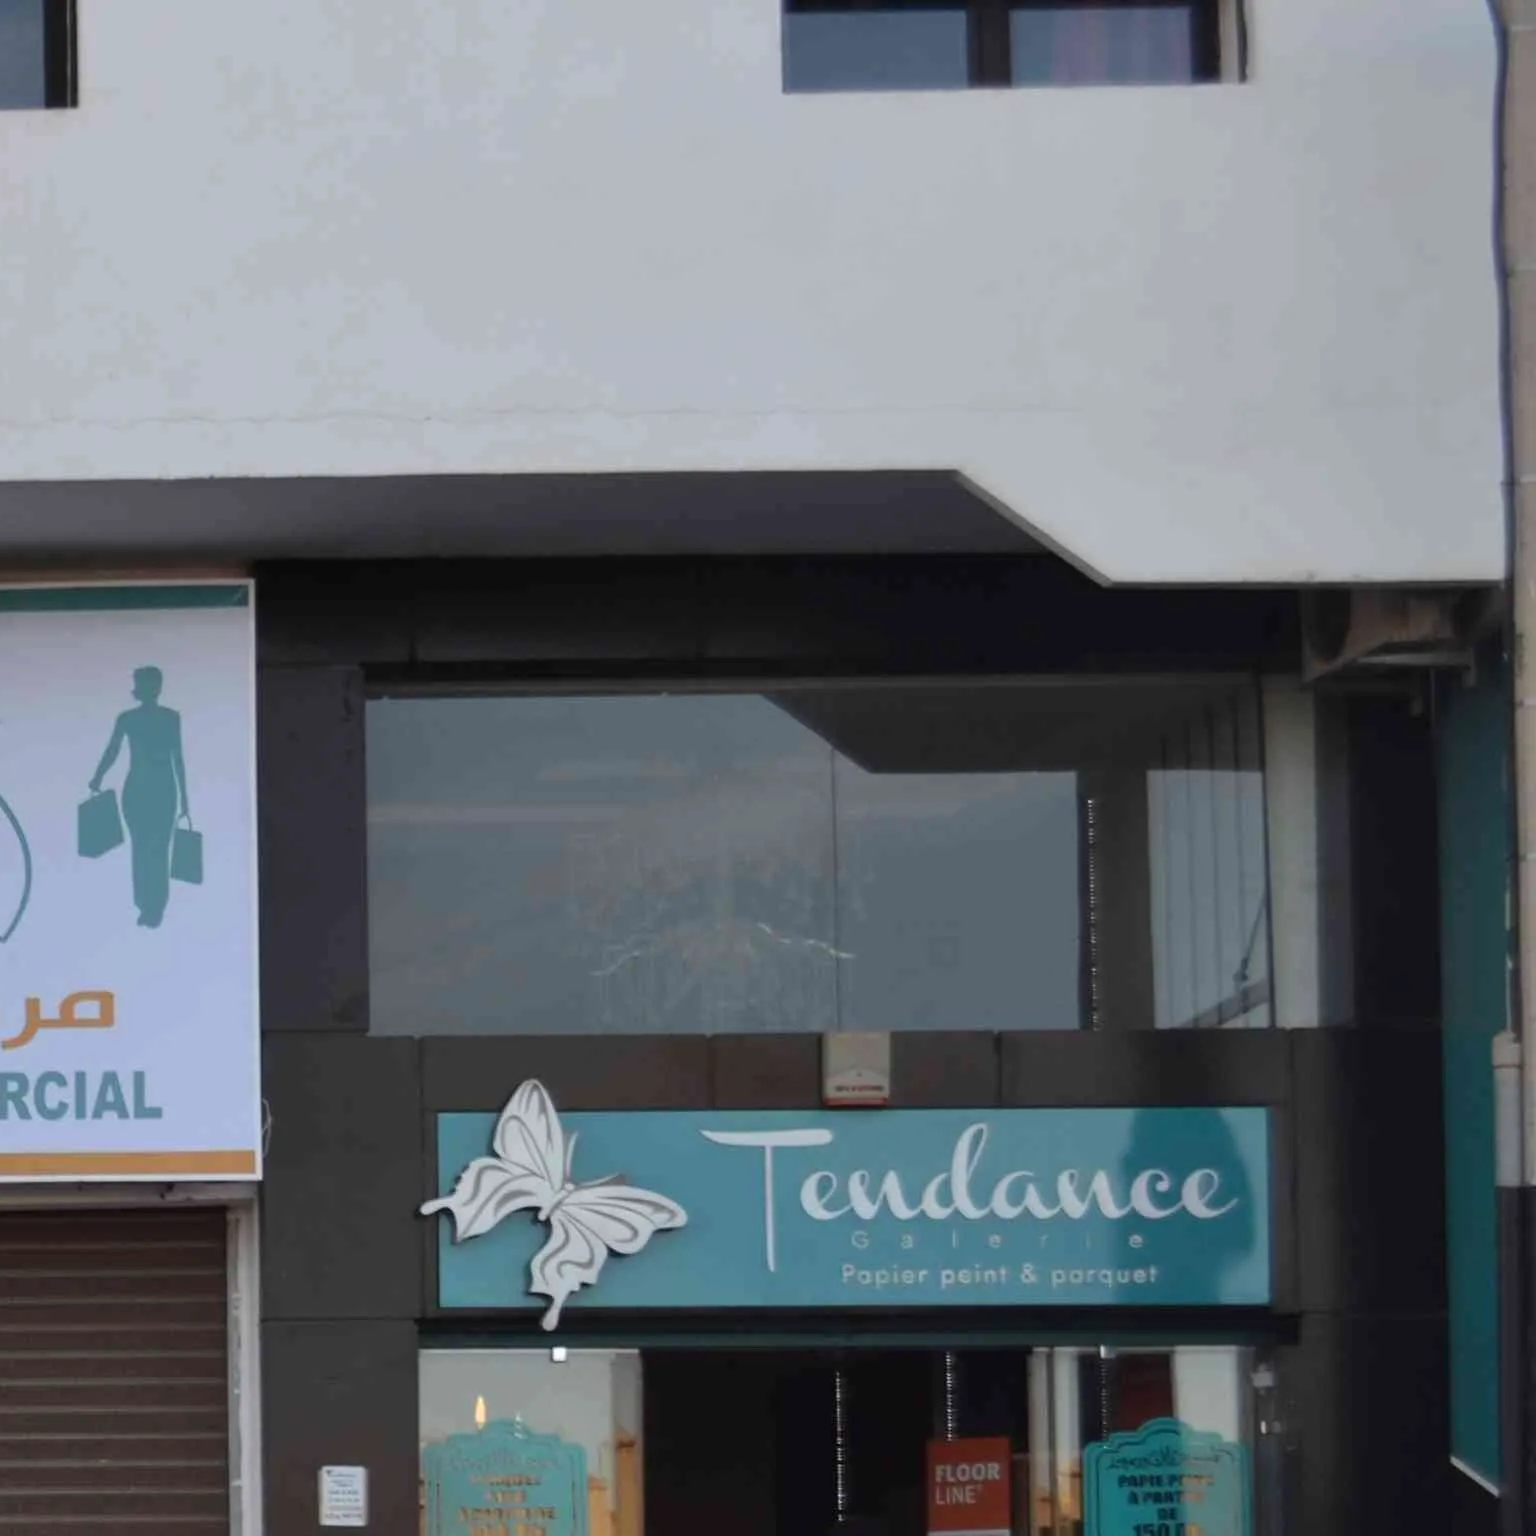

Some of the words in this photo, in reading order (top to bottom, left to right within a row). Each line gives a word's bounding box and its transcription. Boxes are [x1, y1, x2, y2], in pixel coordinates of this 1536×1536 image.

[699, 1122, 1239, 1274] Tendance
[850, 1230, 1144, 1250] Galerie
[841, 1263, 928, 1290] Papier
[940, 1264, 1009, 1289] peint
[1019, 1263, 1039, 1284] &
[1051, 1264, 1159, 1289] parquet
[934, 1462, 1001, 1483] FLOOR
